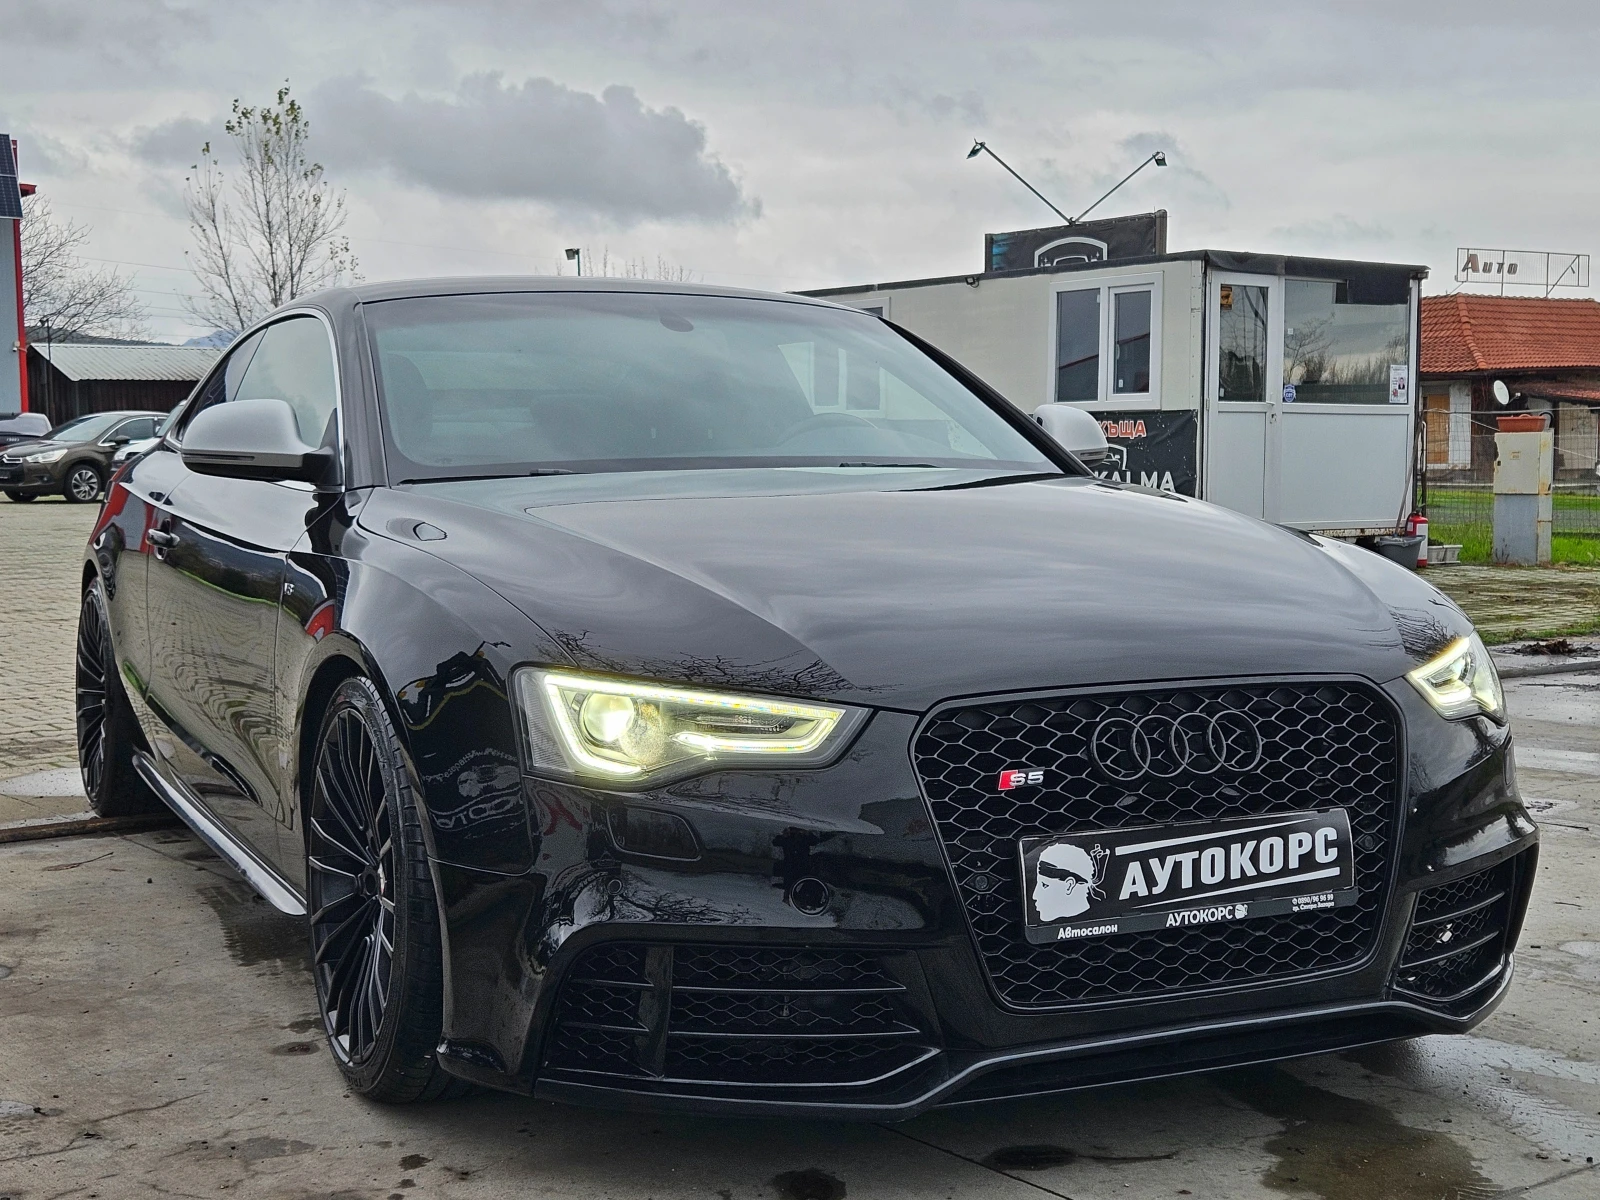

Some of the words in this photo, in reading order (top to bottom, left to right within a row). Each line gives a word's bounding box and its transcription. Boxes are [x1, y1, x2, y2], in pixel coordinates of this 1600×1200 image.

[1009, 770, 1044, 787] S5
[1119, 827, 1338, 900] АУТОКОРС
[1165, 905, 1234, 928] АУТОКОРС
[1057, 924, 1118, 940] Автосалон
